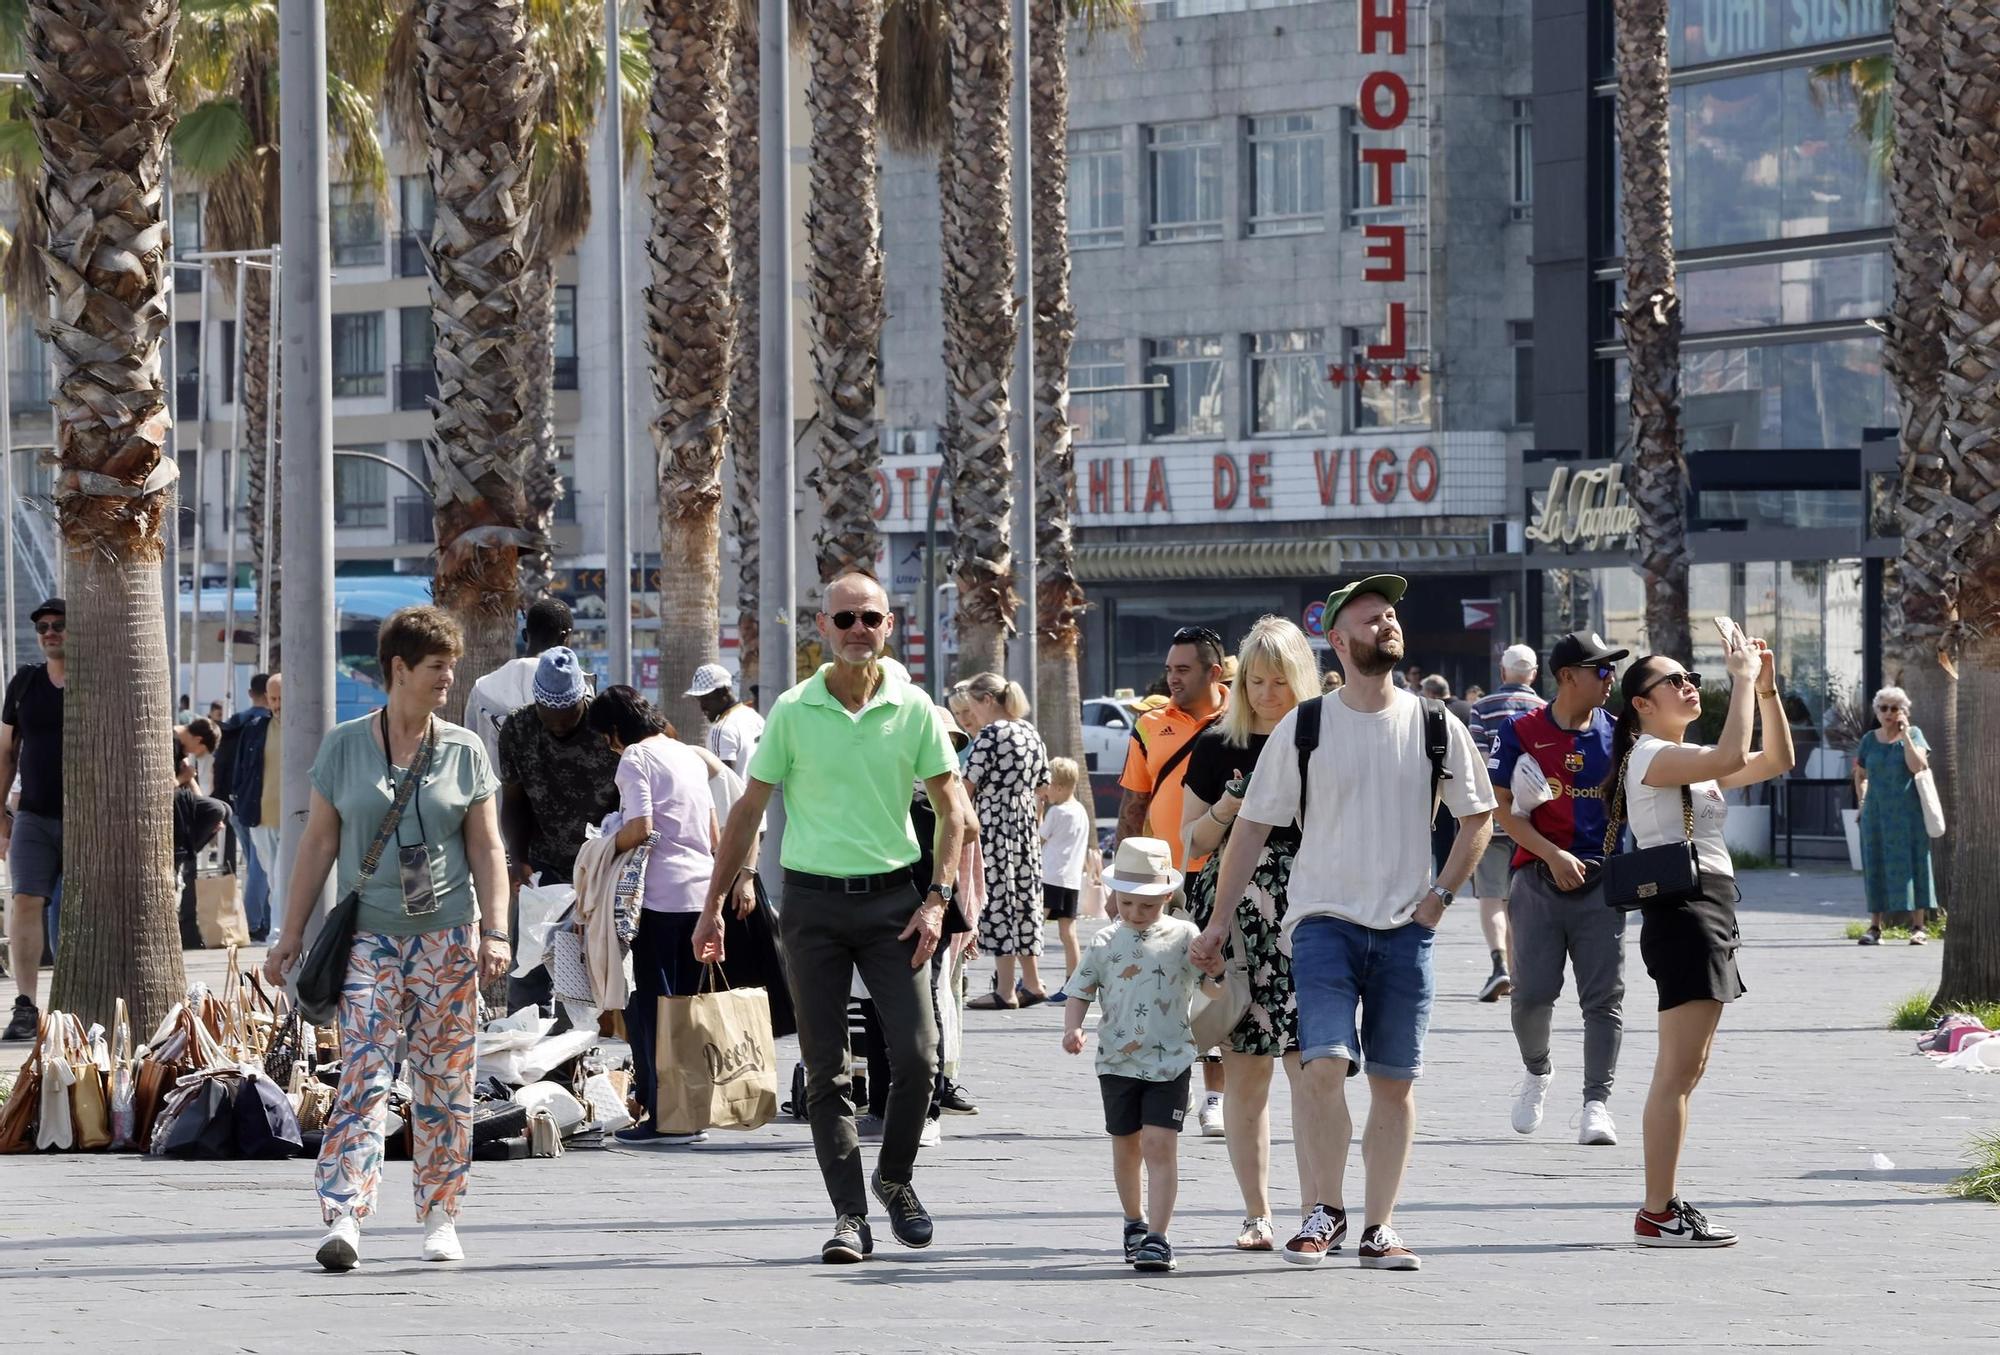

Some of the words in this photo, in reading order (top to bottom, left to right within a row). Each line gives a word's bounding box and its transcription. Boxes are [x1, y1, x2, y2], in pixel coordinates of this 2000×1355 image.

[871, 466, 945, 520] OTE
[1066, 457, 1170, 514] HIA
[1213, 452, 1271, 510] DE
[1313, 446, 1440, 506] VIGO
[1524, 466, 1568, 543] La
